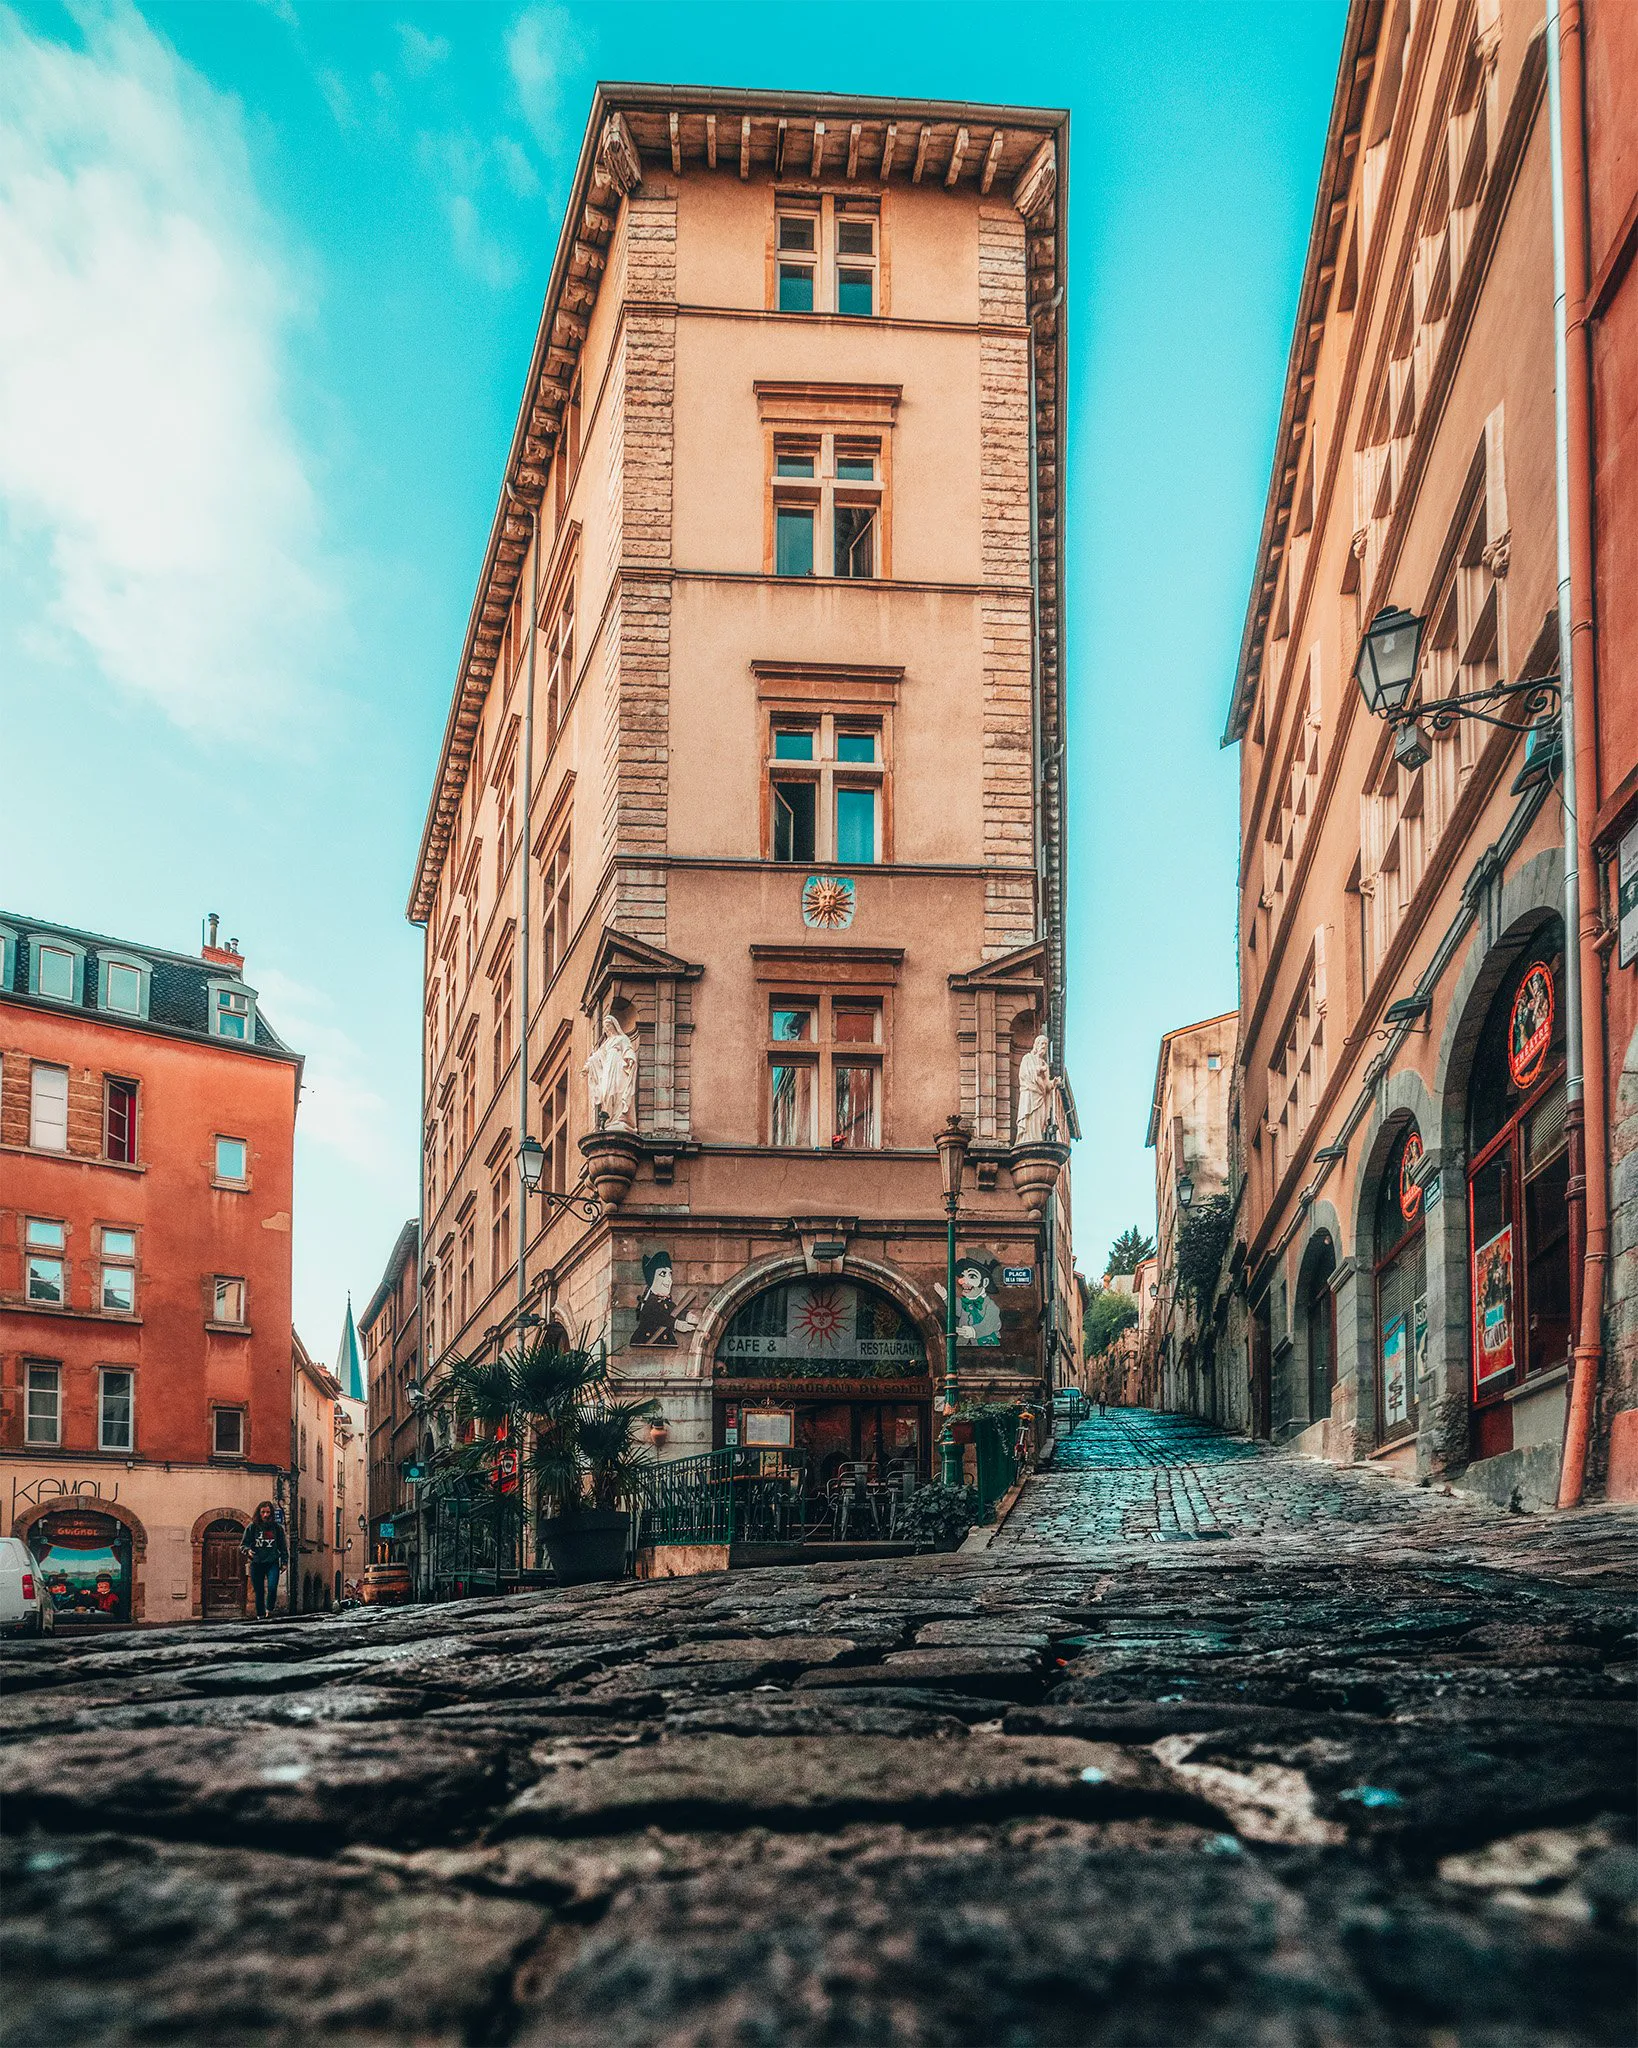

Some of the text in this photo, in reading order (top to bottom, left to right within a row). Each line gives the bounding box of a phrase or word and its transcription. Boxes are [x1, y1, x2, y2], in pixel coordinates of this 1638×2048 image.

[727, 1339, 921, 1357] CAFE & RESTAURANT
[859, 1384, 879, 1394] DU
[255, 1539, 275, 1548] NY
